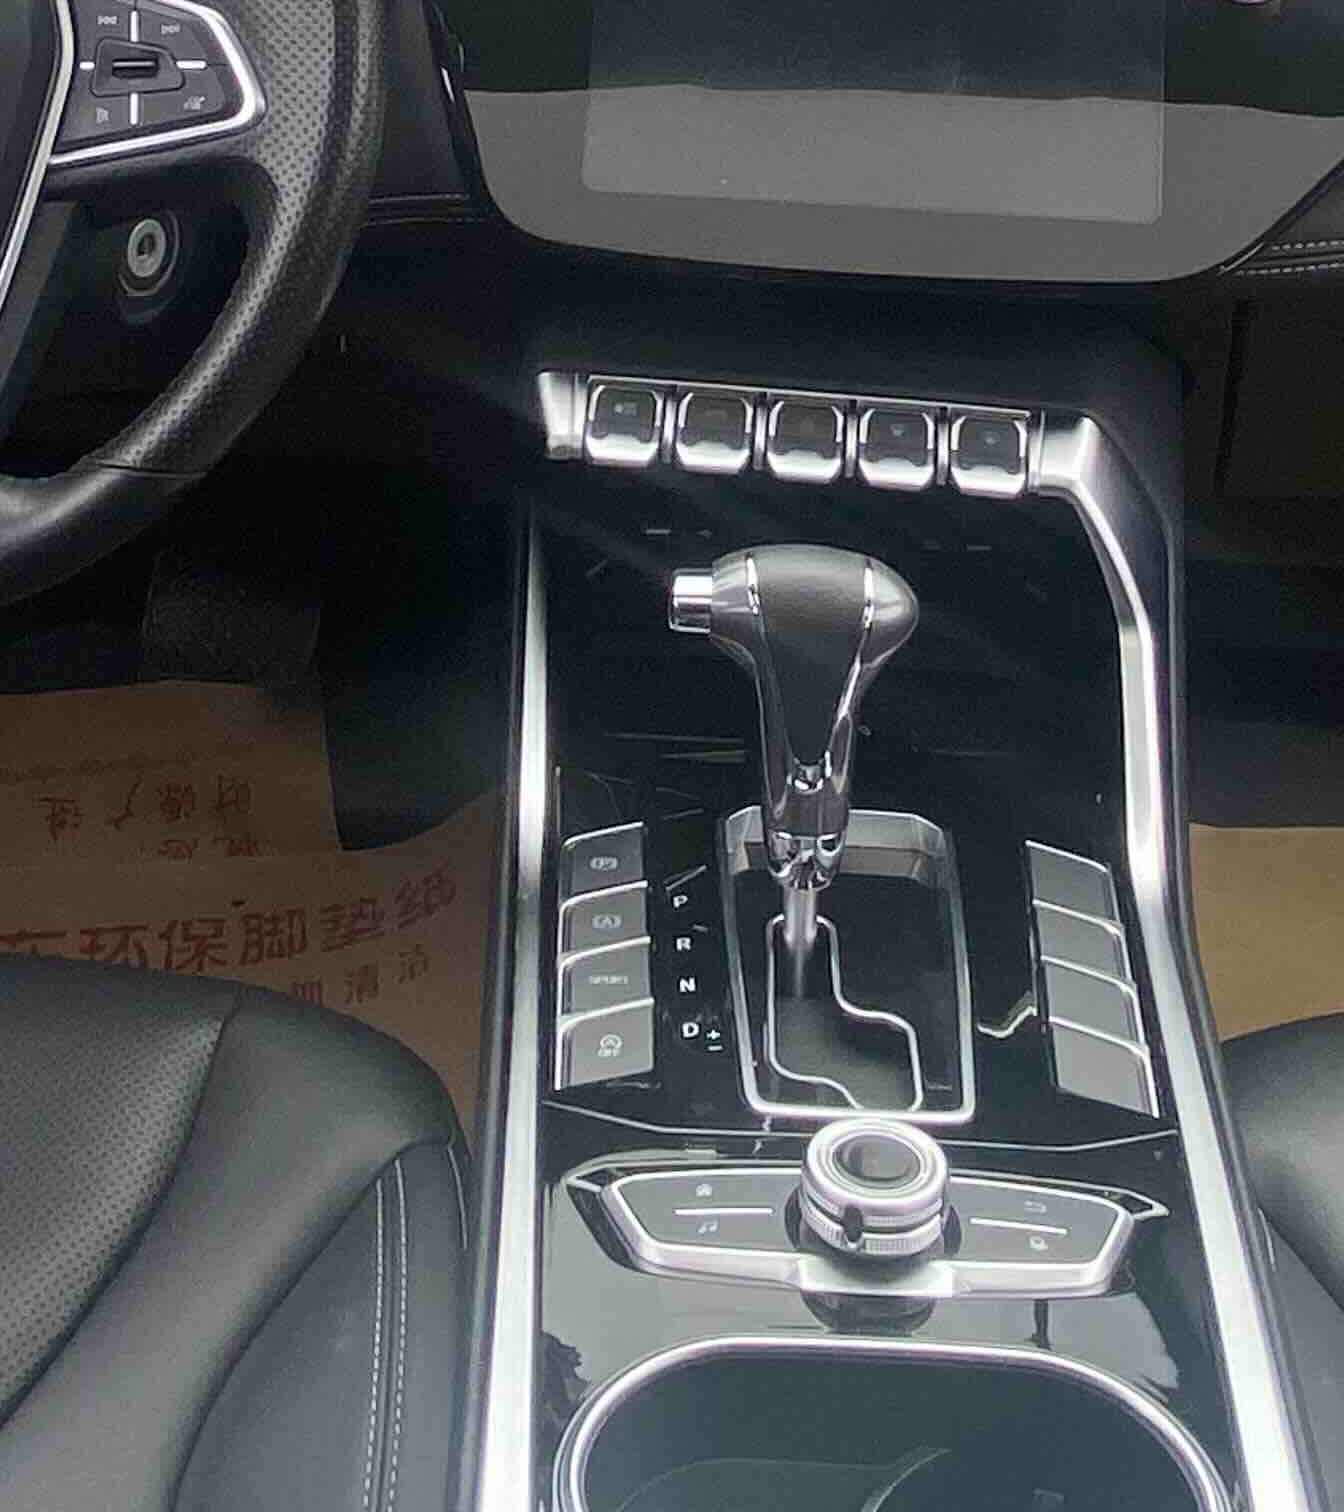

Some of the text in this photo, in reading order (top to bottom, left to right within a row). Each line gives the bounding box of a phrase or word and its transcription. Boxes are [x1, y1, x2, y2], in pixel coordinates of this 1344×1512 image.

[673, 895, 688, 909] P
[676, 937, 692, 951] R
[679, 977, 696, 993] N
[683, 1022, 699, 1038] D
